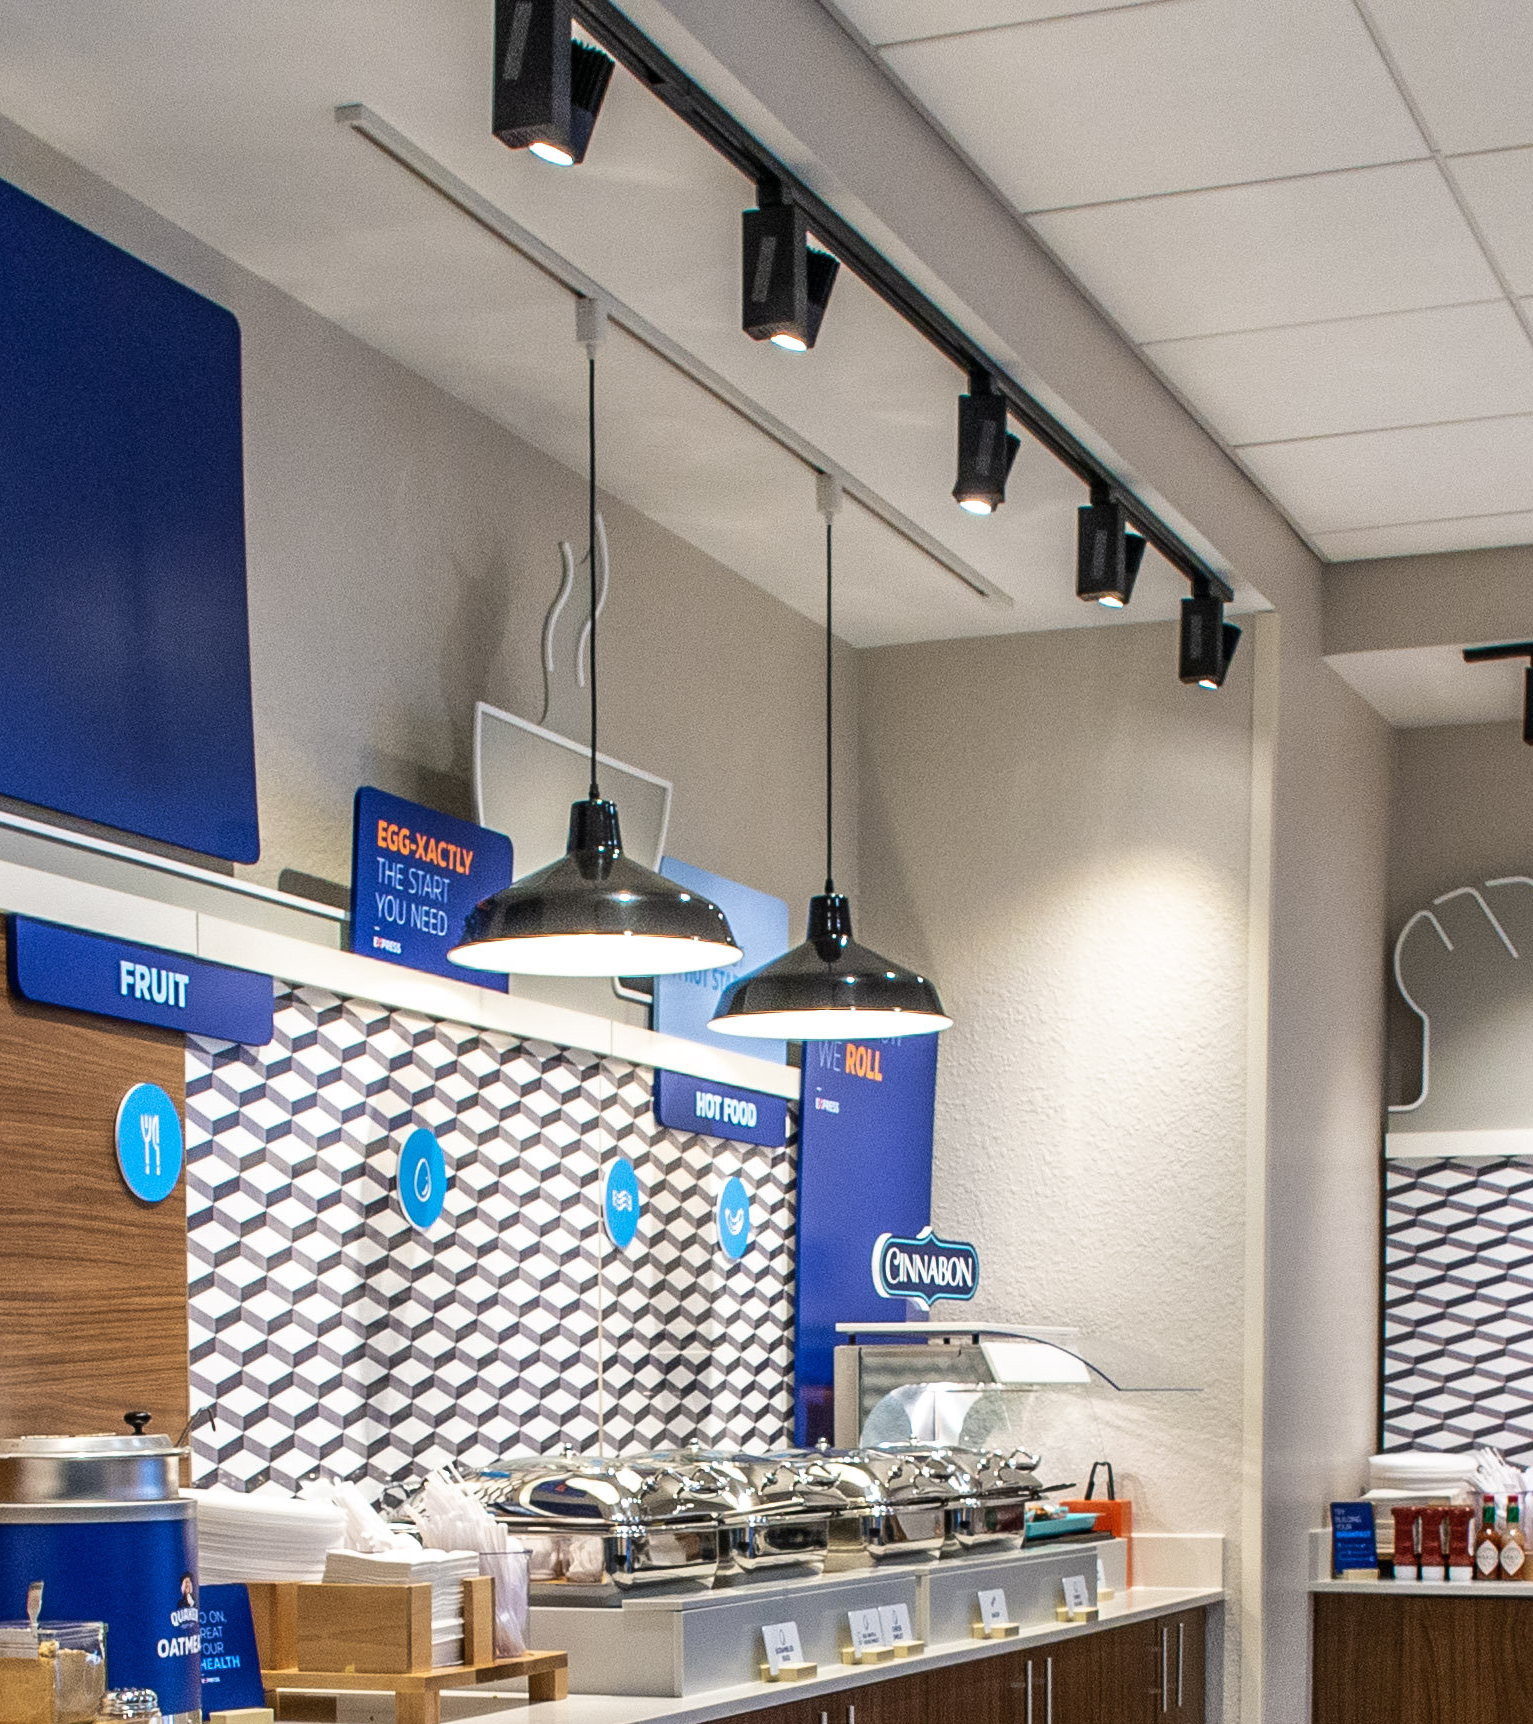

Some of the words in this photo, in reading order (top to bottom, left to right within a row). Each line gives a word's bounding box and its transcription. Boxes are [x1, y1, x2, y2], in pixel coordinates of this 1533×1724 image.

[377, 819, 474, 875] EGG-XACTLY
[376, 857, 404, 891] THE
[408, 868, 451, 904] START
[375, 892, 407, 925] YOU
[411, 903, 448, 936] NEED
[120, 960, 190, 1008] FRUIT
[818, 1041, 842, 1072] WE
[845, 1043, 883, 1082] ROLL
[696, 1091, 722, 1120] HOT
[723, 1097, 757, 1128] FOOD
[200, 1626, 223, 1639] REAT
[201, 1642, 224, 1655] OUR
[201, 1655, 241, 1669] HEALTH
